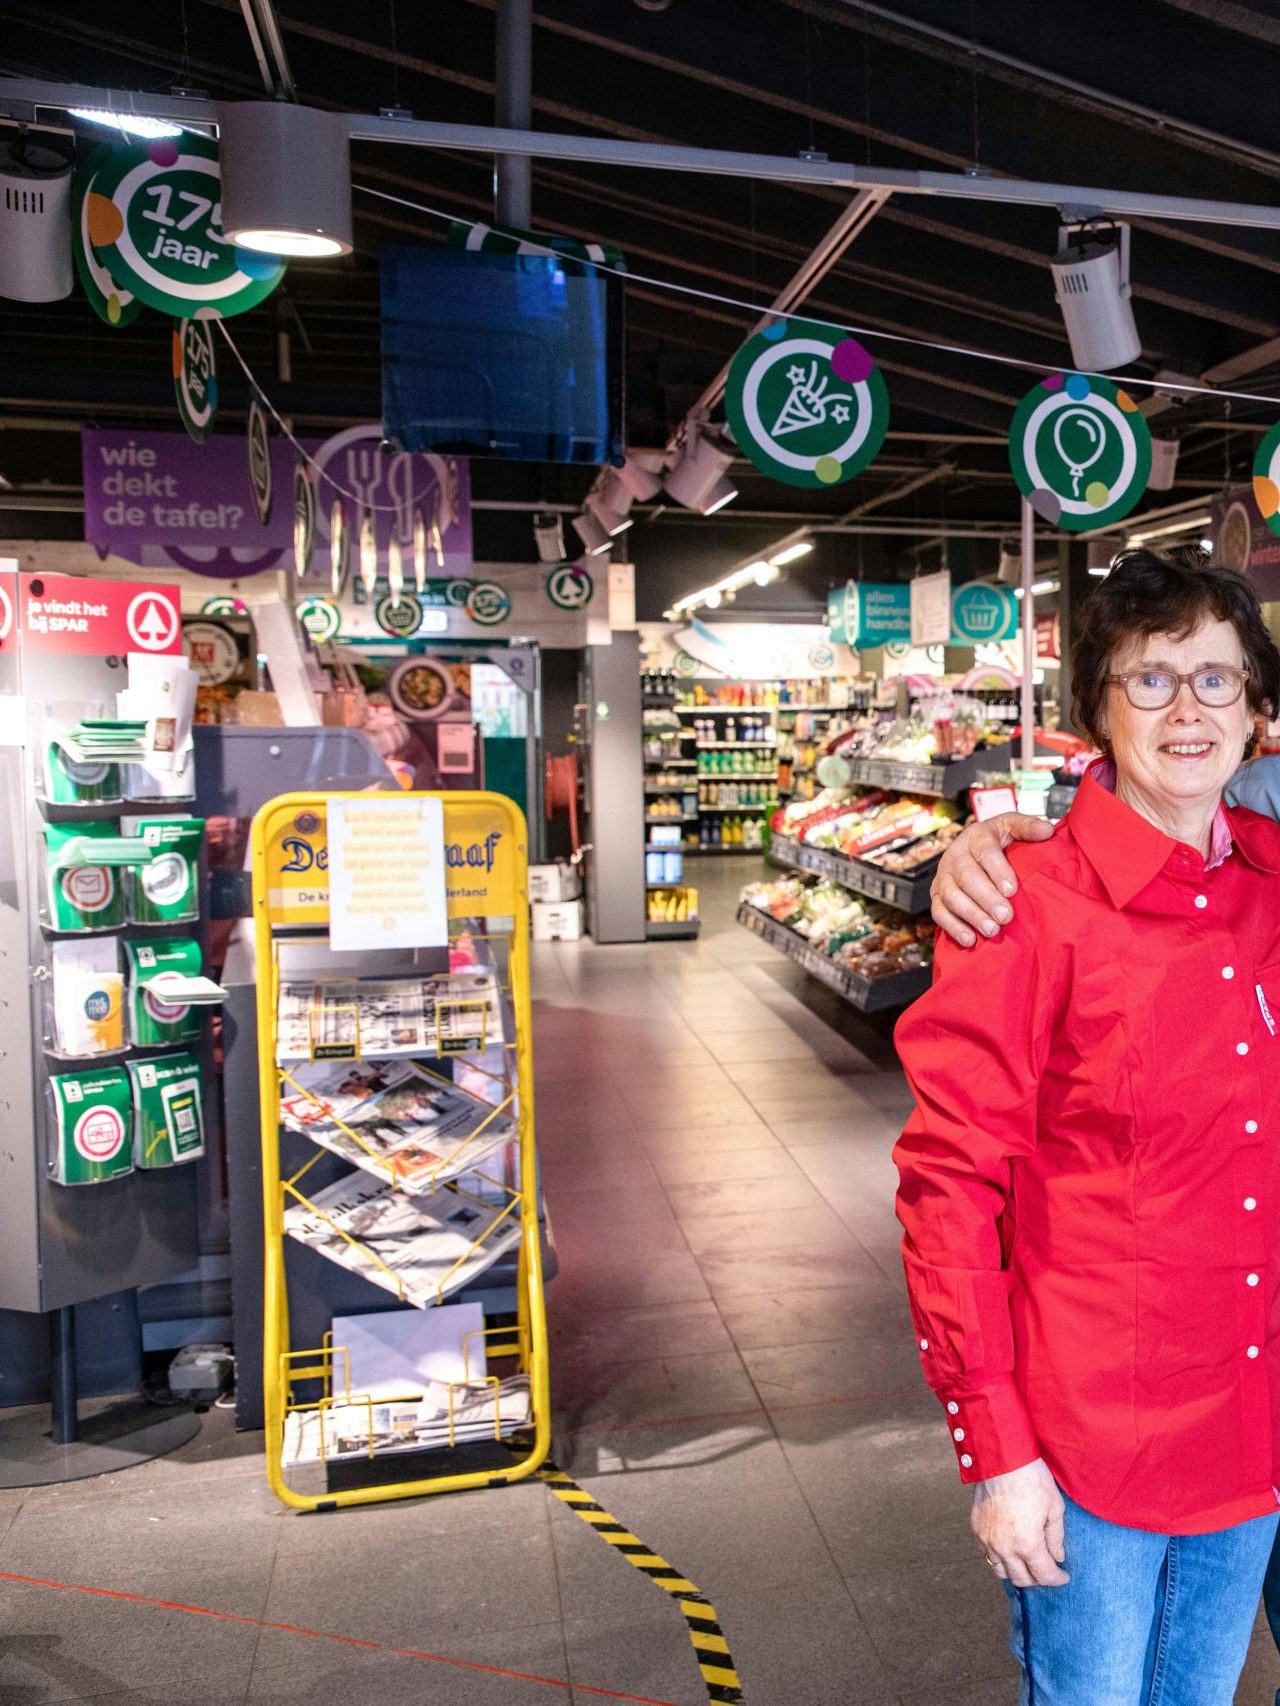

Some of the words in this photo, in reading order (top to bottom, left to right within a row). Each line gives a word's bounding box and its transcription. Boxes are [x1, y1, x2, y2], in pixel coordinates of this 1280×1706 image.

[147, 228, 219, 269] jaar
[100, 440, 157, 467] wie
[102, 470, 178, 497] dekt
[103, 501, 145, 526] de
[152, 503, 244, 529] tafel?
[27, 597, 42, 616] je
[43, 599, 82, 615] vindt
[84, 600, 108, 616] het
[28, 616, 47, 634] bij
[50, 617, 88, 632] SPAR
[280, 836, 328, 872] De
[298, 891, 316, 902] De
